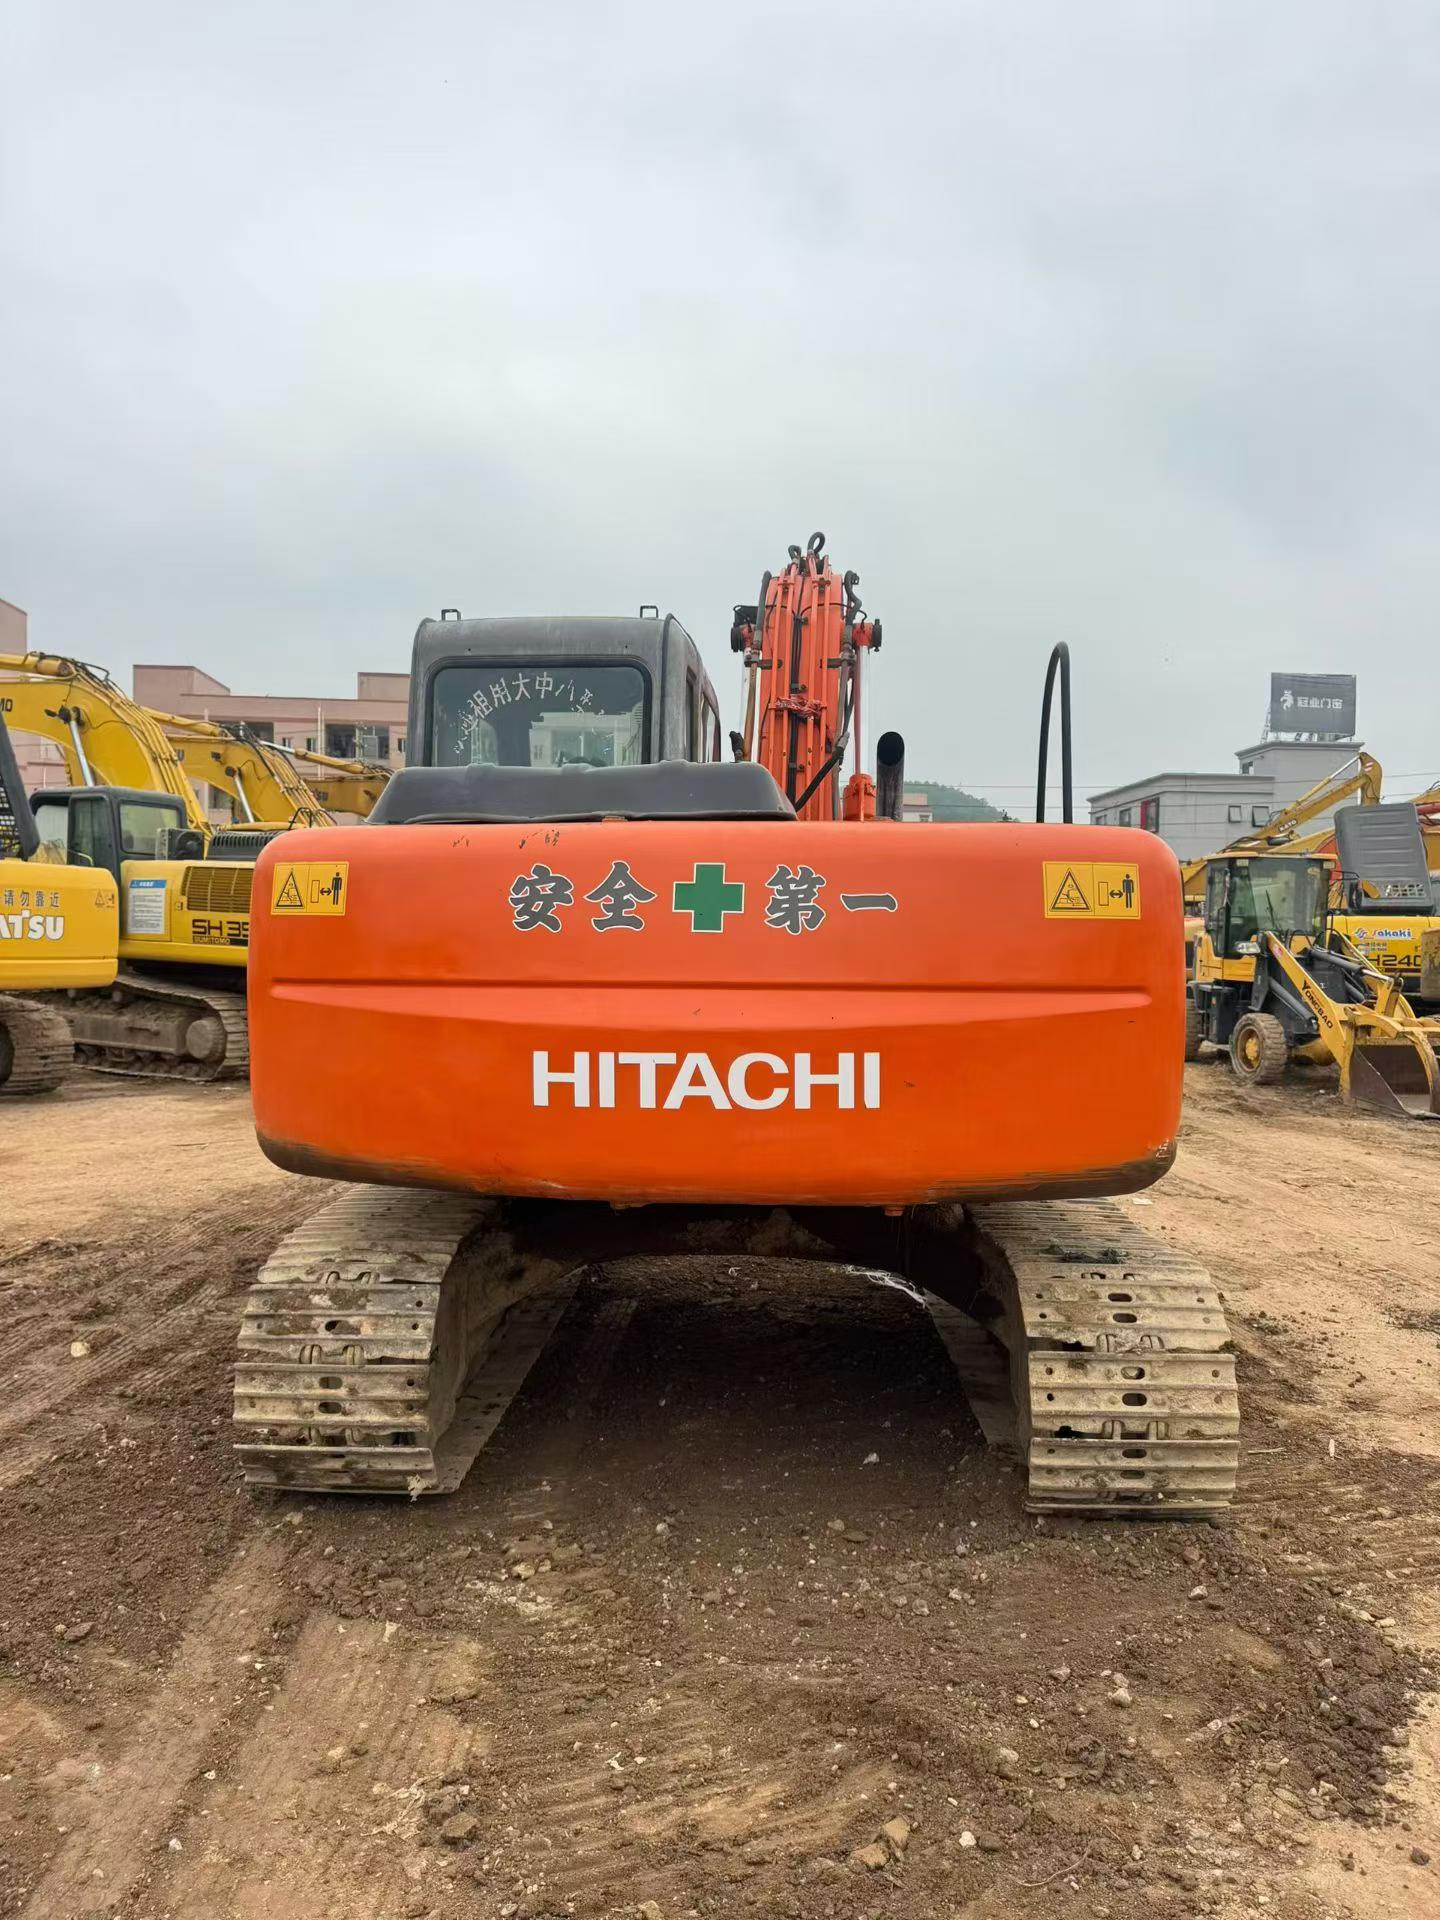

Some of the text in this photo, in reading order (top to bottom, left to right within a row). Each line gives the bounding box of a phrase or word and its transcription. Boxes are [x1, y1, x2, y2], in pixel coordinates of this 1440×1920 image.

[4, 889, 60, 908] 请勿靠近
[509, 860, 898, 935] 安全 第一
[192, 919, 223, 936] SH
[533, 1051, 880, 1110] HITACHI
